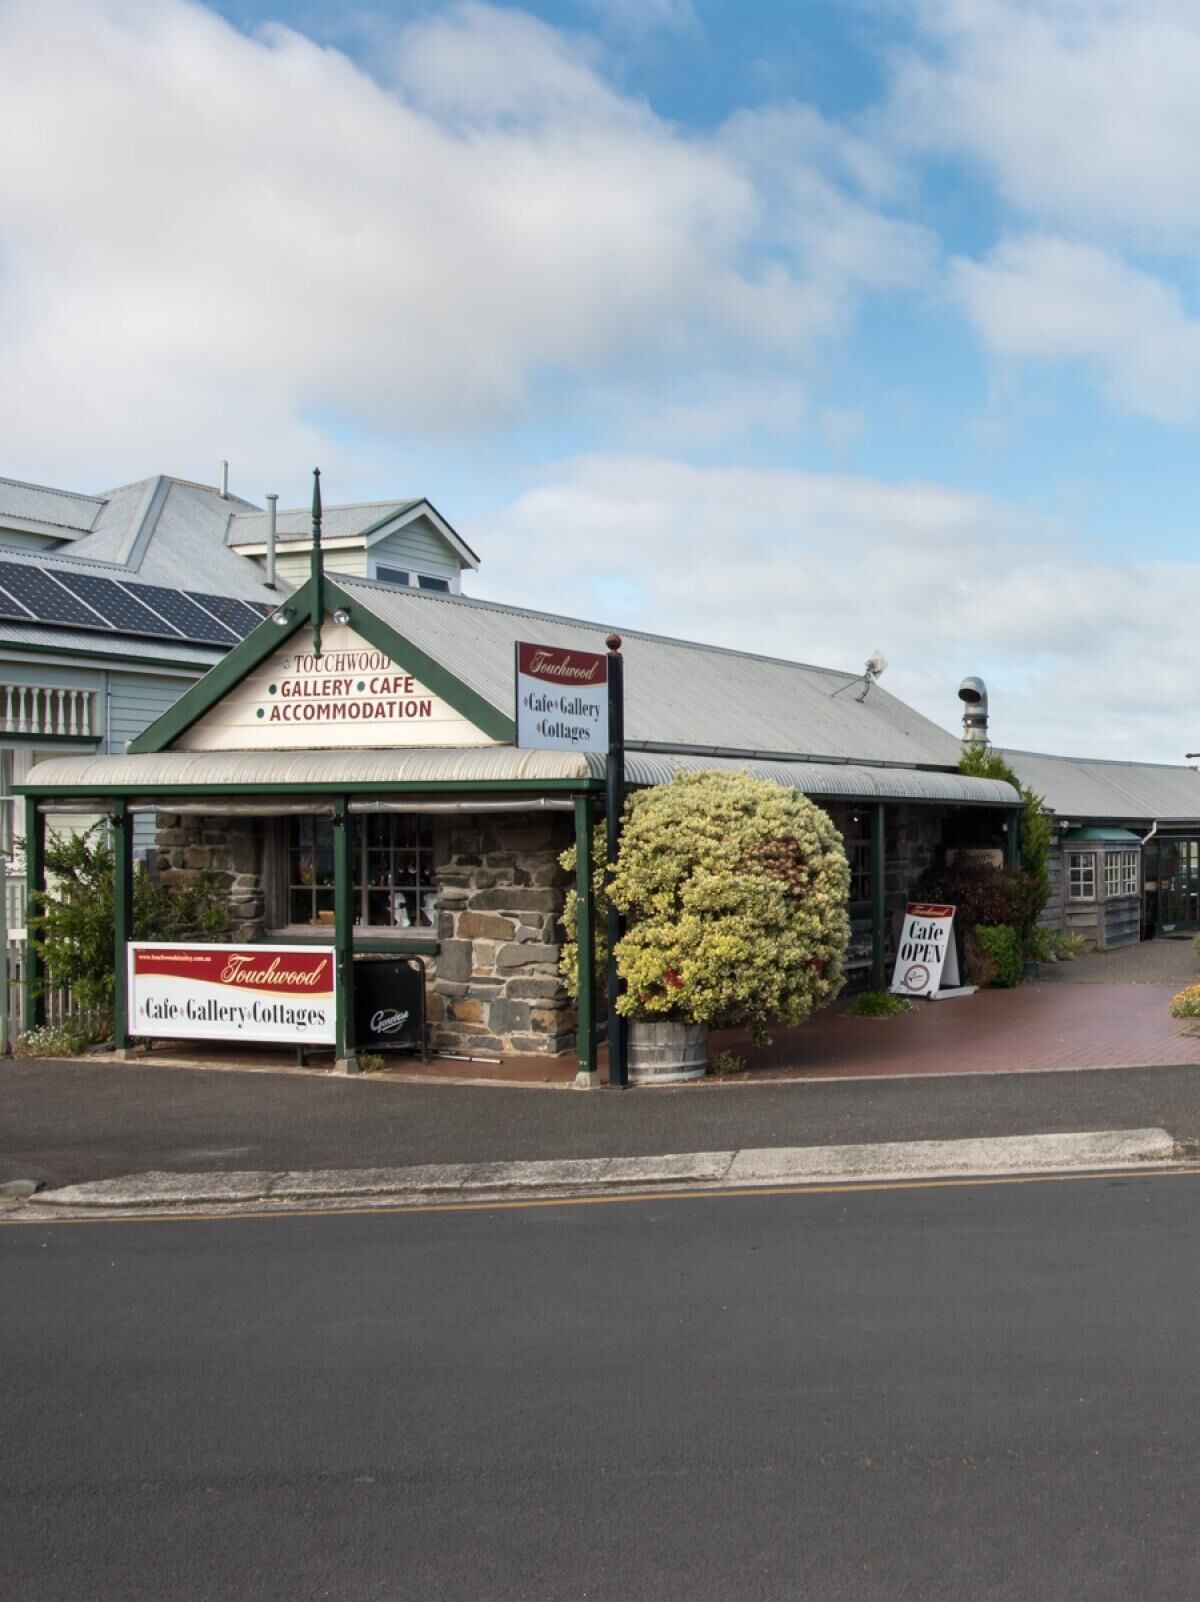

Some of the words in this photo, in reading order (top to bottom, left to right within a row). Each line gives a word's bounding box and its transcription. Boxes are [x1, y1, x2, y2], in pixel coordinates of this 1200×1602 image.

[294, 652, 391, 673] TOUCHWOOD
[529, 649, 600, 680] Touchwood
[281, 679, 354, 698] GALLERY
[370, 676, 415, 694] CAFE
[269, 700, 432, 721] ACCOMMODATION
[529, 692, 553, 713] Cafe
[560, 696, 601, 722] Gallery
[542, 718, 590, 744] Cottages
[909, 920, 944, 941] Cafe
[901, 943, 945, 963] OPEN
[221, 953, 328, 986] Touchwood
[146, 997, 178, 1019] Cafe
[186, 999, 247, 1029] Gallery
[252, 1000, 326, 1031] Cottages
